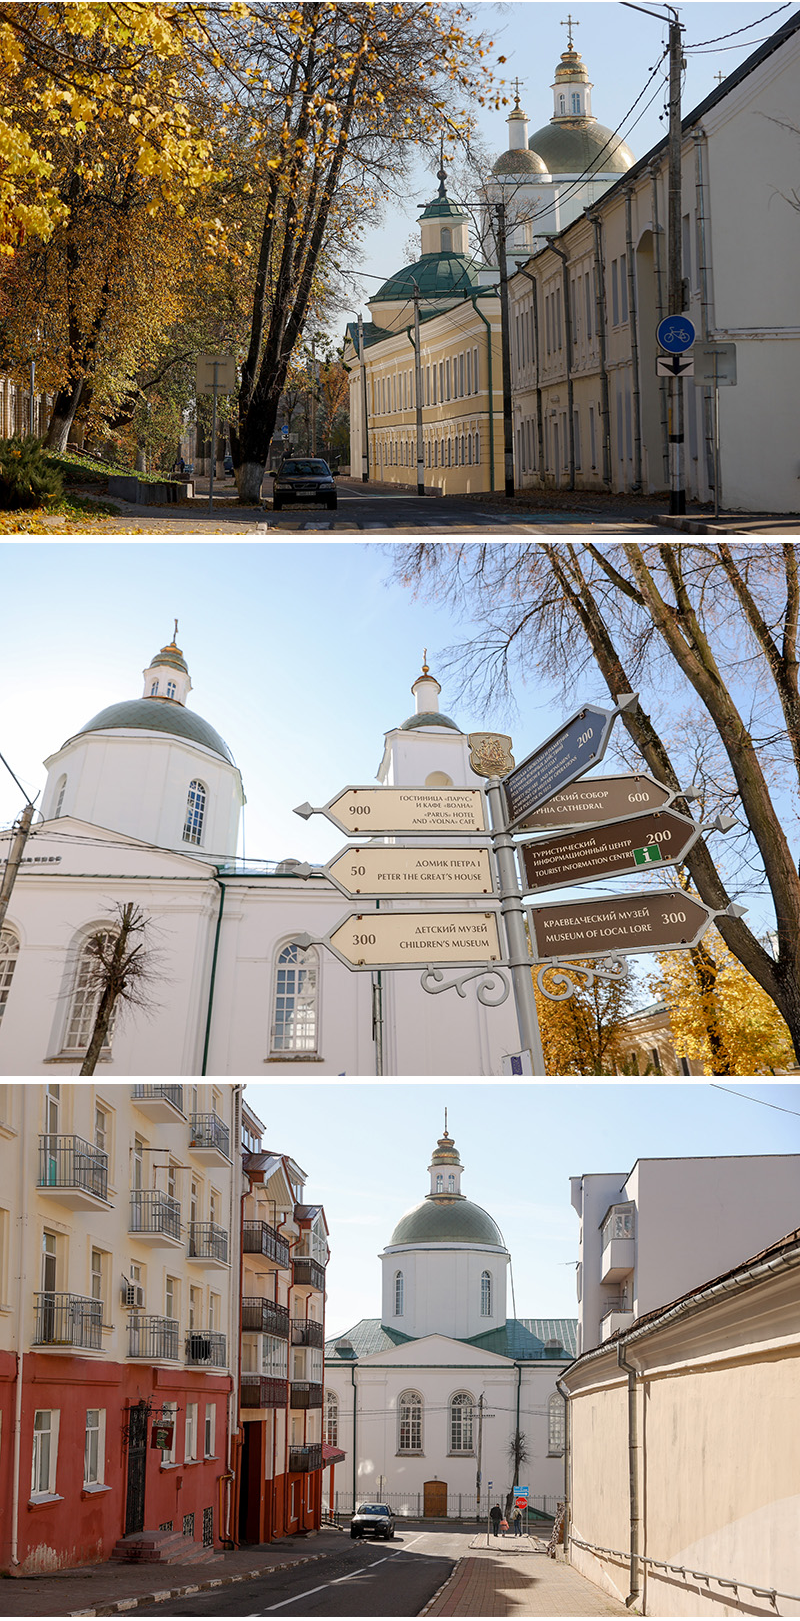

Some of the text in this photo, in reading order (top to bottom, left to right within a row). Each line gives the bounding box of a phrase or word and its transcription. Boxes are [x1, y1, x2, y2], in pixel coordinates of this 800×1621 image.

[576, 727, 594, 748] 200
[580, 791, 609, 799] СОБОР
[628, 792, 650, 803] 600
[349, 806, 371, 815] 900
[557, 802, 604, 813] CATHEDRAL
[646, 830, 672, 844] 200
[532, 838, 596, 858] ТУРИСТИЧЕСКИЙ
[533, 839, 632, 866] ИНФОРМАЦИОННЫЙ ЦЕНТР
[415, 860, 449, 868] ДОМИК
[535, 851, 634, 877] TOURIST INFORMATION CENTRE
[351, 866, 366, 876] 50
[543, 907, 650, 928] КРАЕВЕДЧЕСКИЙ МУЗЕЙ
[661, 912, 687, 925] 300
[415, 923, 488, 934] ДЕТСКИЙ МУЗЕЙ
[546, 924, 652, 942] MUSEUM OF LOCAL LORE
[352, 934, 376, 945] 300
[400, 940, 450, 949] CHILDREN'S
